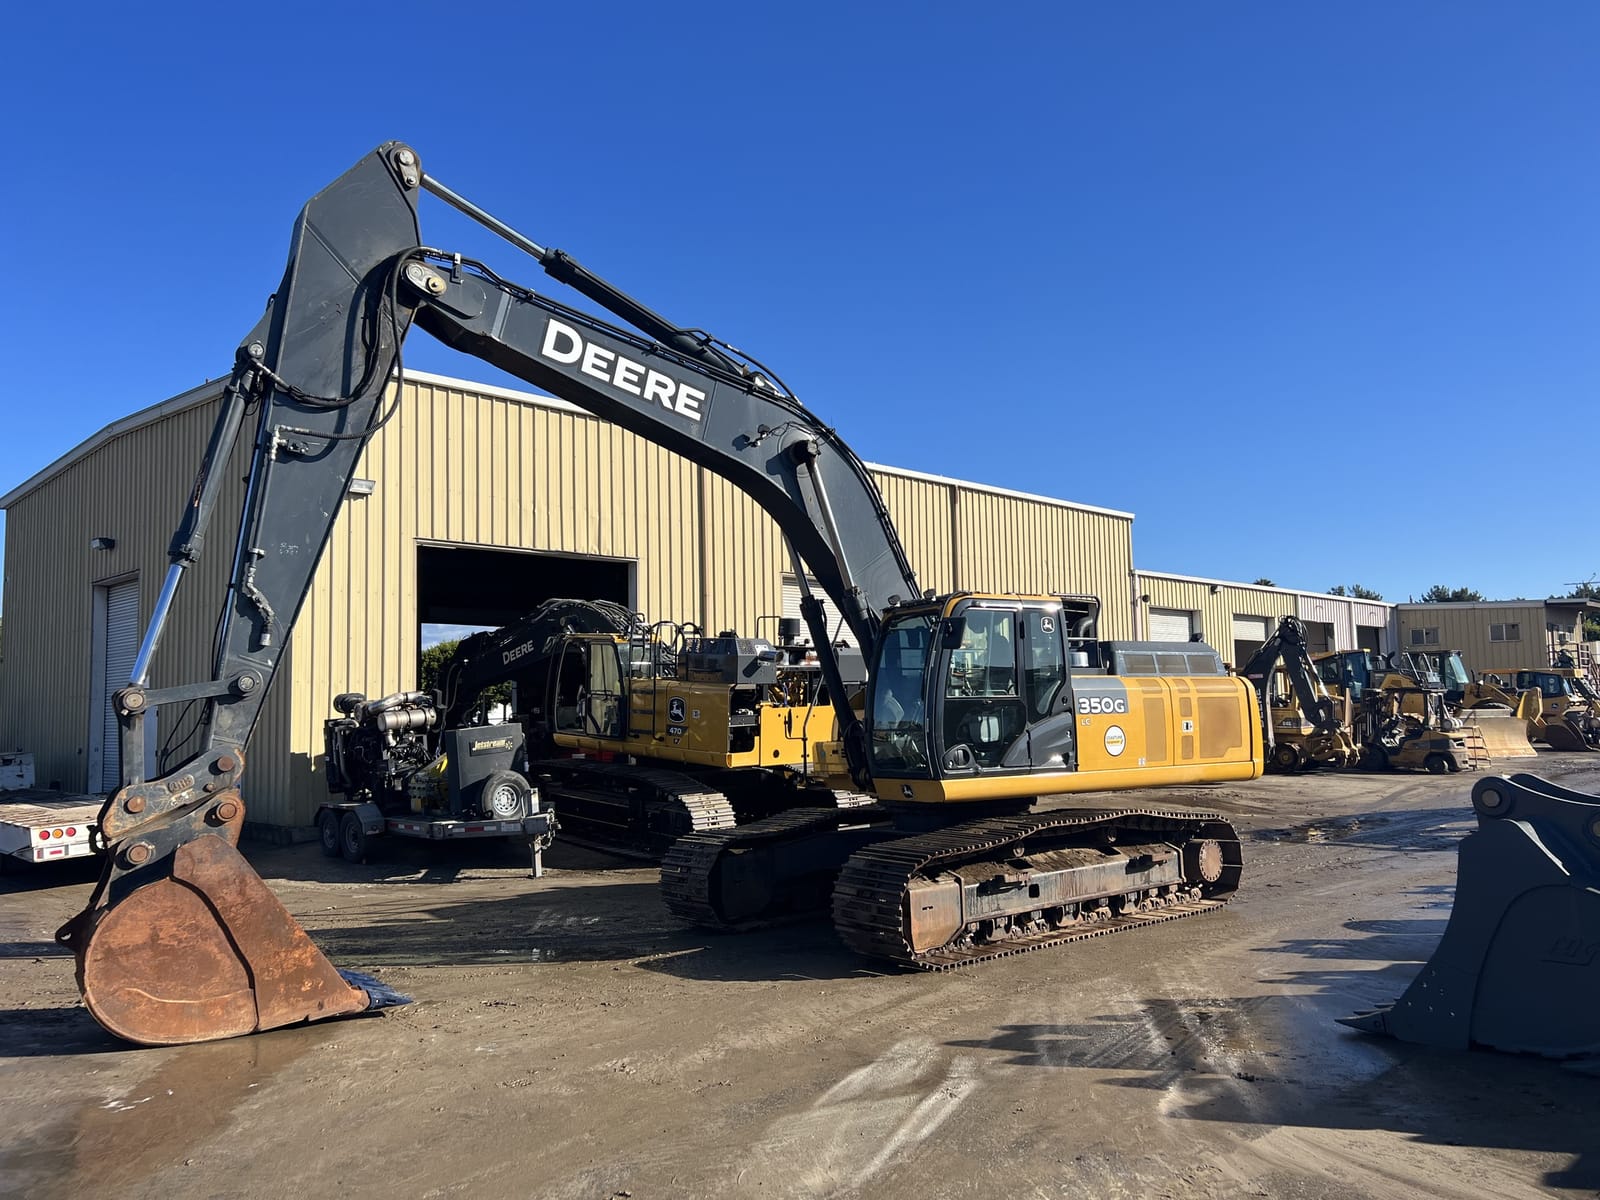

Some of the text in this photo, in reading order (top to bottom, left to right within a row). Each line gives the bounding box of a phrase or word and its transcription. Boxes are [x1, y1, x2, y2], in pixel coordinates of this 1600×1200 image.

[542, 318, 705, 421] DEERE
[503, 640, 534, 665] DEERE
[1079, 698, 1124, 713] 350G
[670, 727, 681, 735] 470
